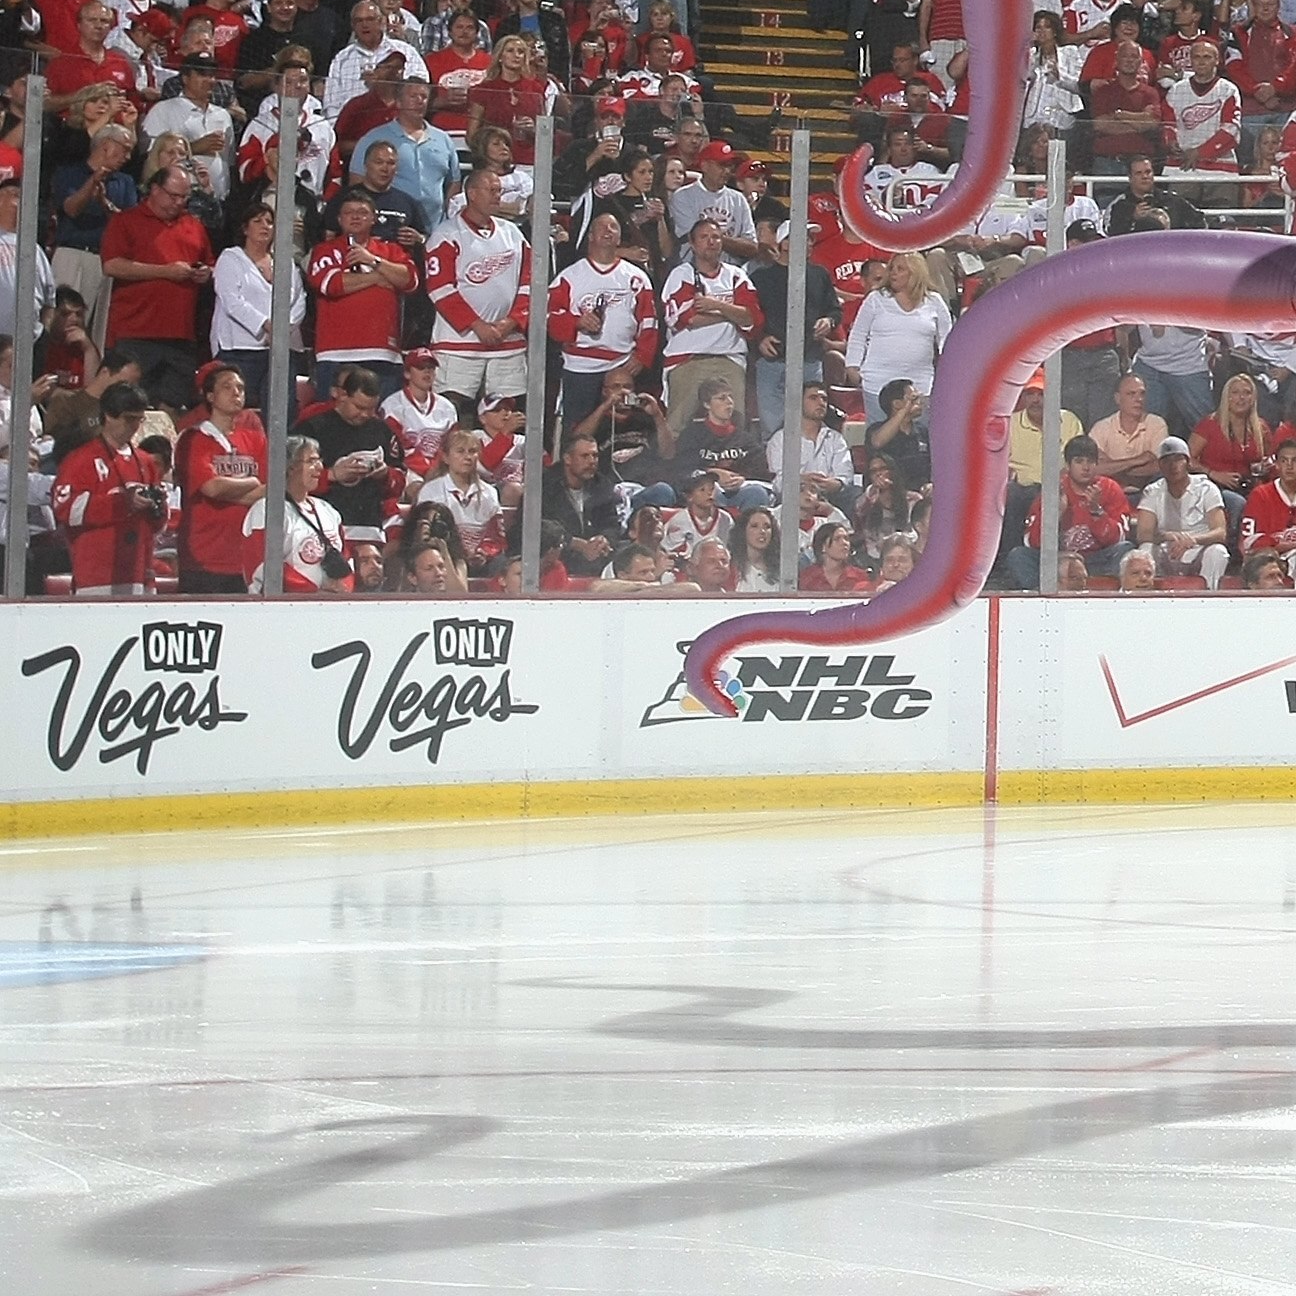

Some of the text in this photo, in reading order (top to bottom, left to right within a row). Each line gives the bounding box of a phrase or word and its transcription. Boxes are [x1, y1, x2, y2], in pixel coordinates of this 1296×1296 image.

[149, 628, 216, 666] ONLY
[440, 625, 507, 661] ONLY
[734, 655, 915, 688] NHL
[21, 635, 249, 776] Vegas
[311, 630, 540, 764] Vegas
[742, 688, 932, 722] NBC
